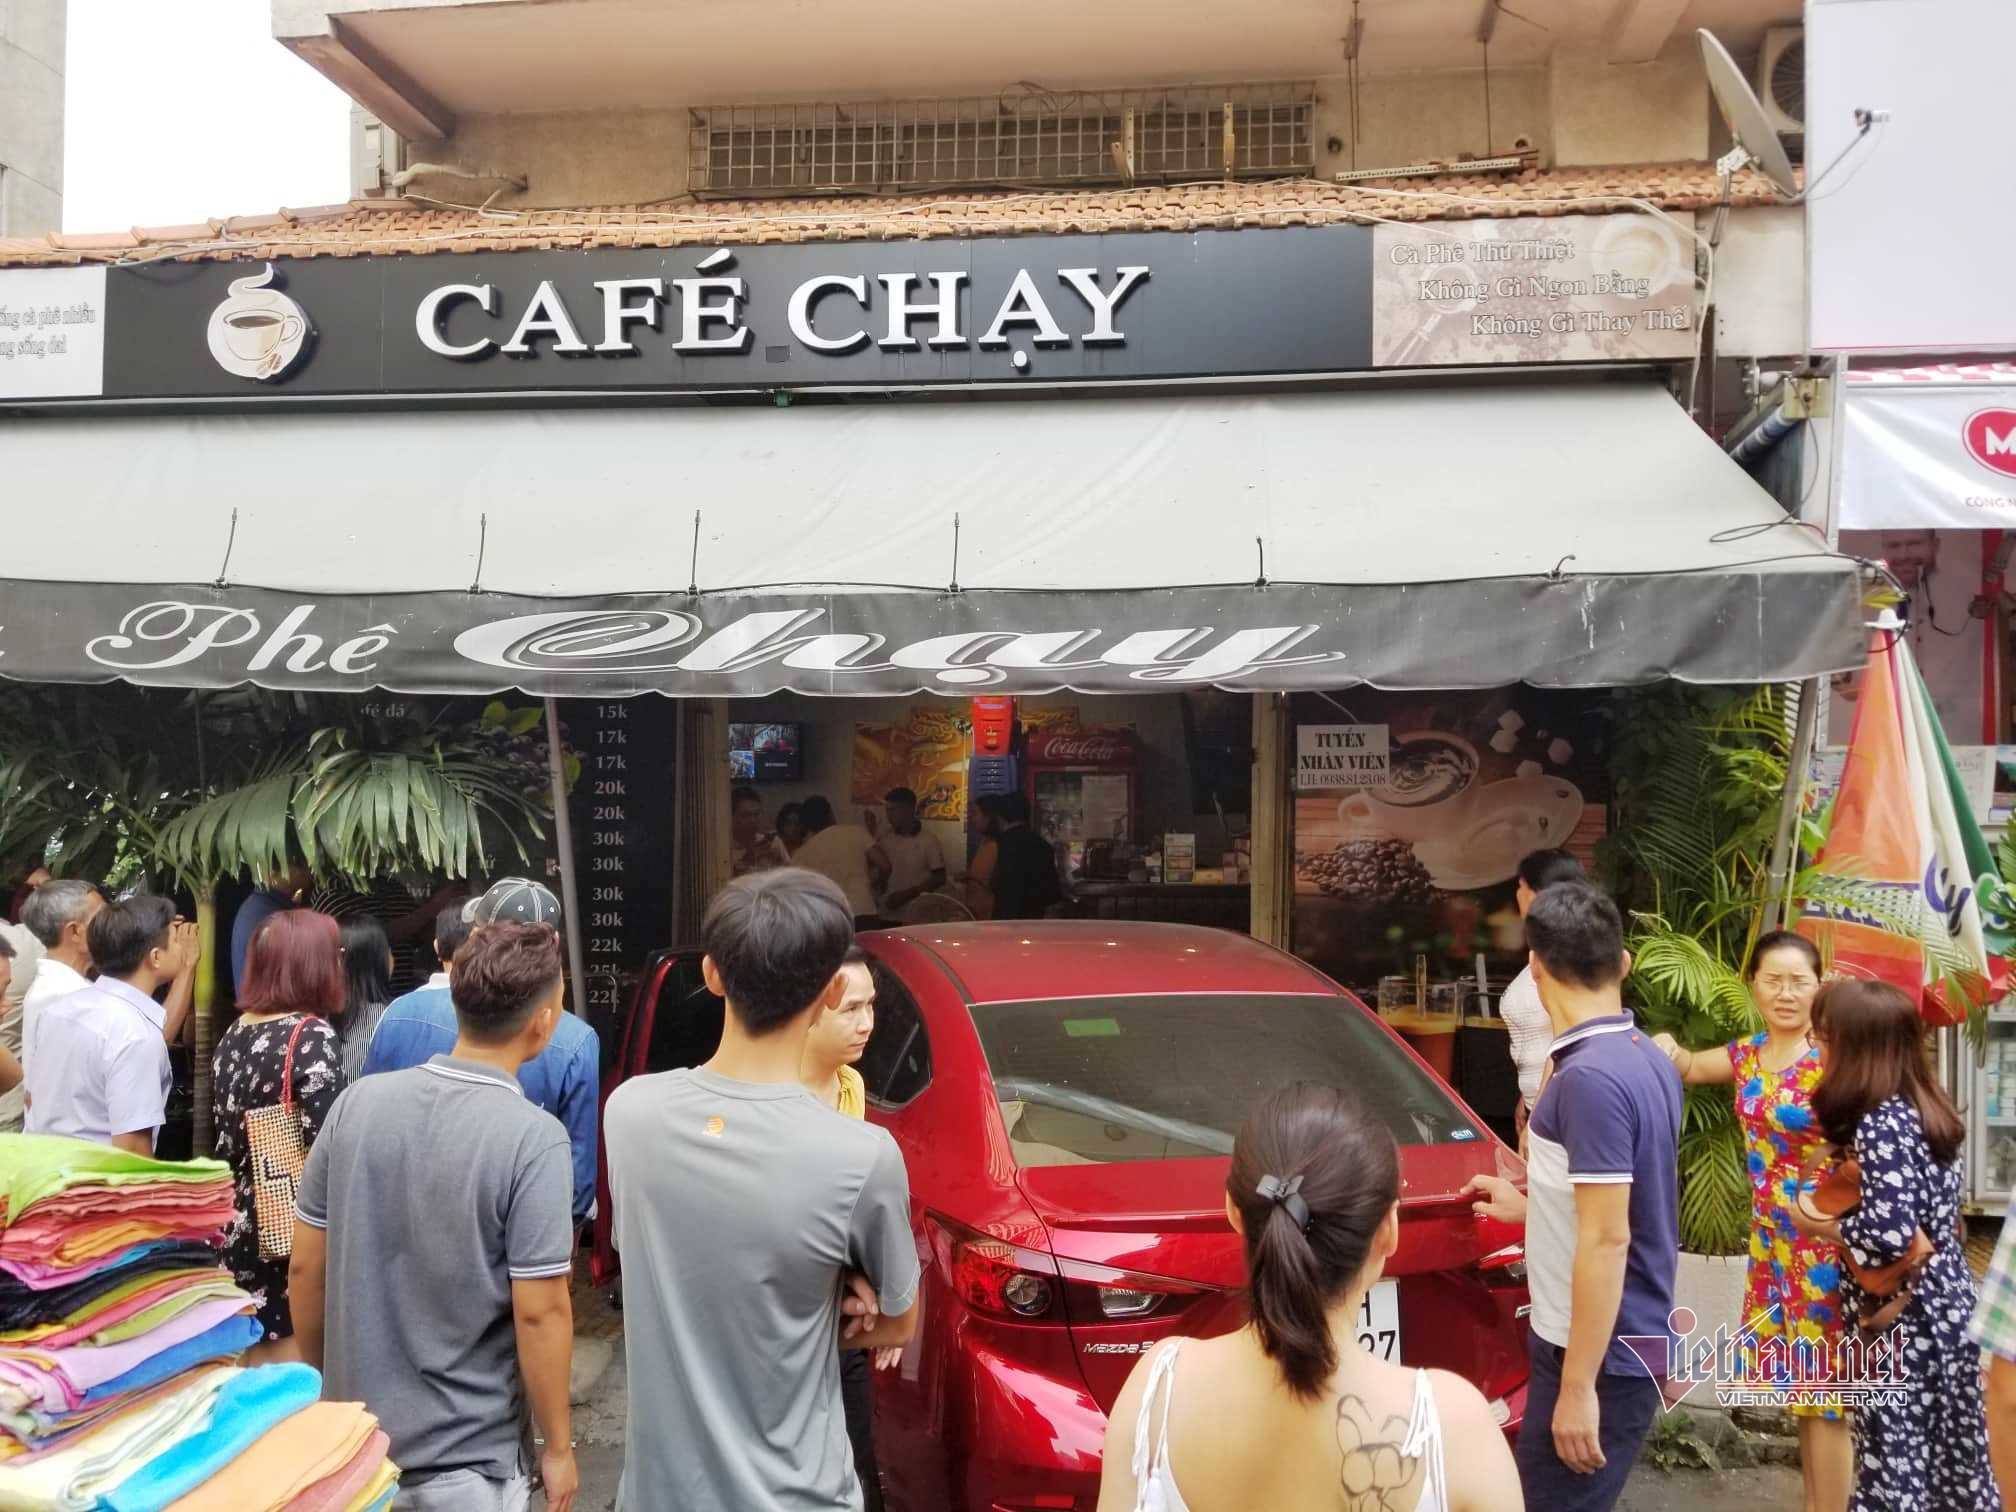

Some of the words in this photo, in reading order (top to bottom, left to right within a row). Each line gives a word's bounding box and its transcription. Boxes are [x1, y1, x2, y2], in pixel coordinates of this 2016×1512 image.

[1423, 240, 1465, 264] Phê
[1416, 279, 1489, 304] Không
[1496, 276, 1523, 299] Gì
[1529, 276, 1587, 302] Ngon
[415, 248, 750, 357] CAFÉ
[787, 266, 1150, 368] CHẠY
[1471, 313, 1543, 338] Không
[1549, 313, 1577, 333] Gì
[1582, 311, 1637, 335] Thay
[1643, 303, 1692, 331] Thế
[85, 600, 399, 675] Phê
[453, 607, 1347, 686] Chạy
[597, 704, 627, 719] 15k
[596, 729, 627, 744] 17k
[596, 755, 626, 769] 17k
[594, 780, 625, 795] 20k
[593, 805, 625, 820] 20k
[592, 831, 624, 846] 30k
[592, 856, 624, 871] 30k
[592, 886, 624, 901] 30k
[591, 912, 623, 927] 30k
[591, 937, 622, 952] 22k
